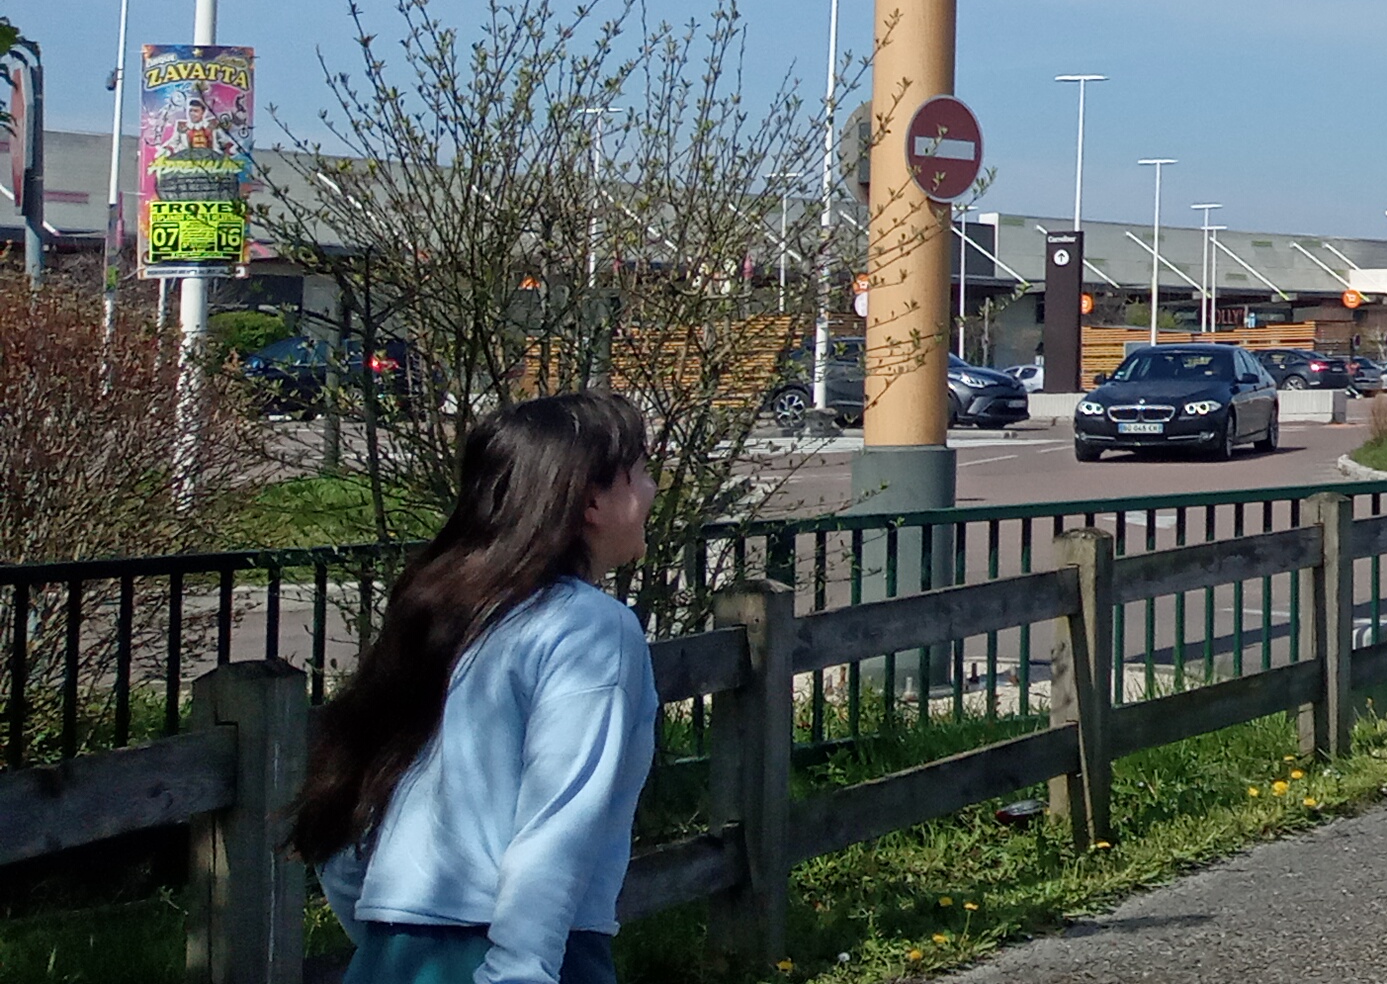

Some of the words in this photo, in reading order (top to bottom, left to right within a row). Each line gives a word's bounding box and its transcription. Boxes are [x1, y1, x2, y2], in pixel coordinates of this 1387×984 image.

[146, 62, 249, 91] ZAVATTA
[153, 227, 179, 247] 07
[218, 227, 241, 247] 16
